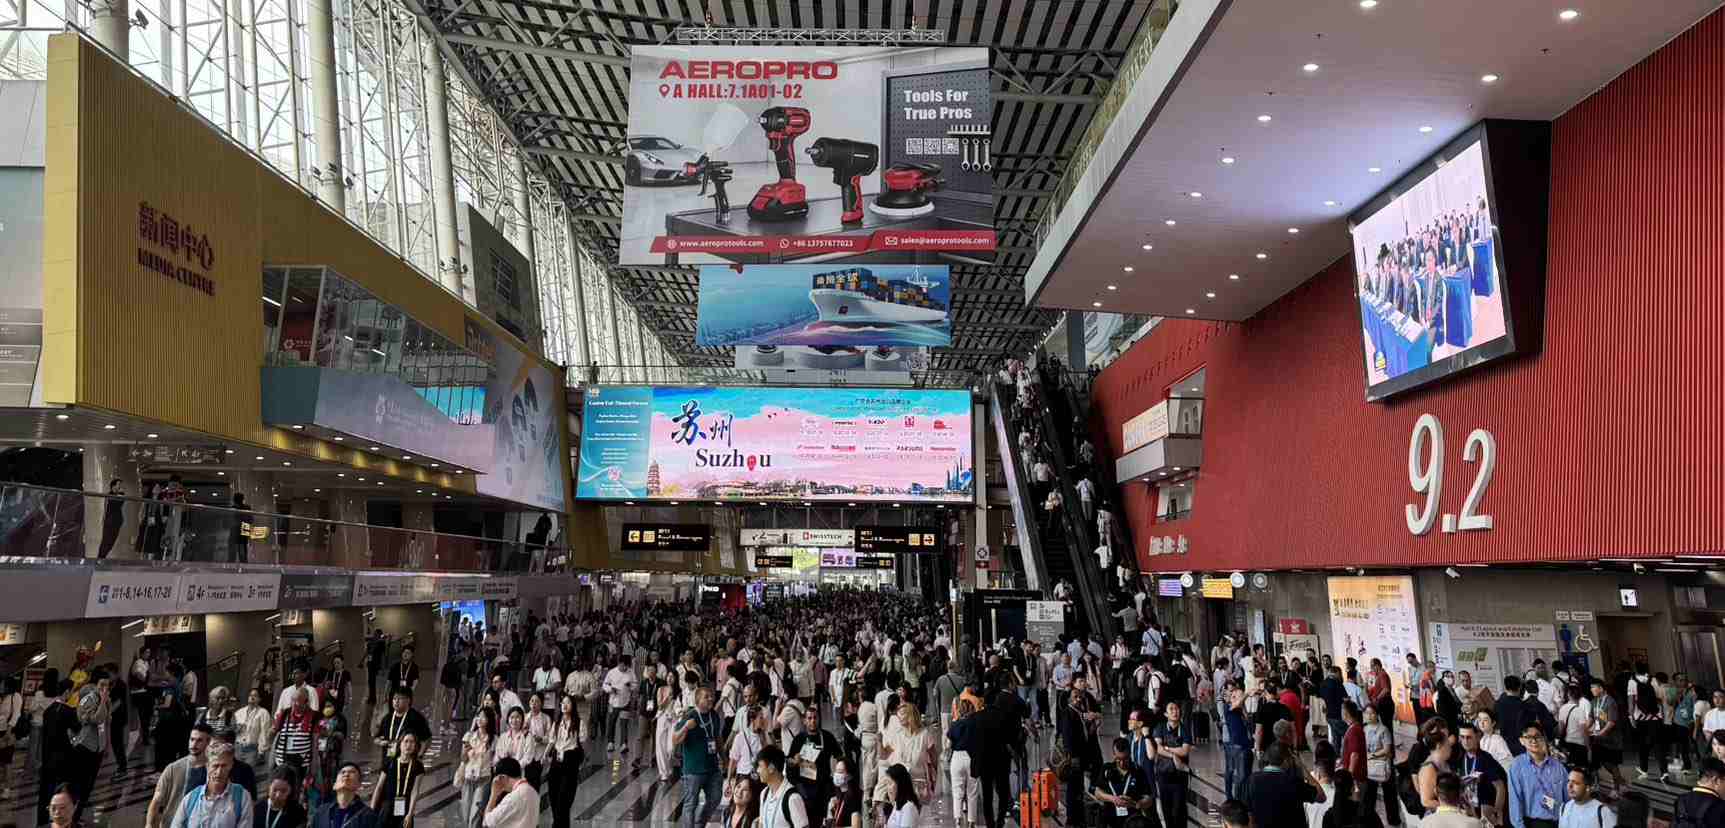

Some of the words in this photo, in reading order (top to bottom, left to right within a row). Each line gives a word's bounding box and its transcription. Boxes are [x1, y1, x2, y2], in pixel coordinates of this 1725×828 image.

[659, 60, 839, 80] AEROPRO
[673, 84, 683, 98] A
[687, 84, 803, 98] HALL:7.1A01-02
[903, 89, 944, 103] Tools
[946, 89, 969, 102] For
[903, 107, 937, 120] True
[939, 106, 973, 120] Pros
[138, 201, 214, 271] 新闻中心
[679, 239, 764, 248] www.aeroprotools.com
[900, 236, 991, 246] sales@aeroprotools.com
[671, 399, 733, 447] 苏州
[1405, 413, 1497, 536] 9.2
